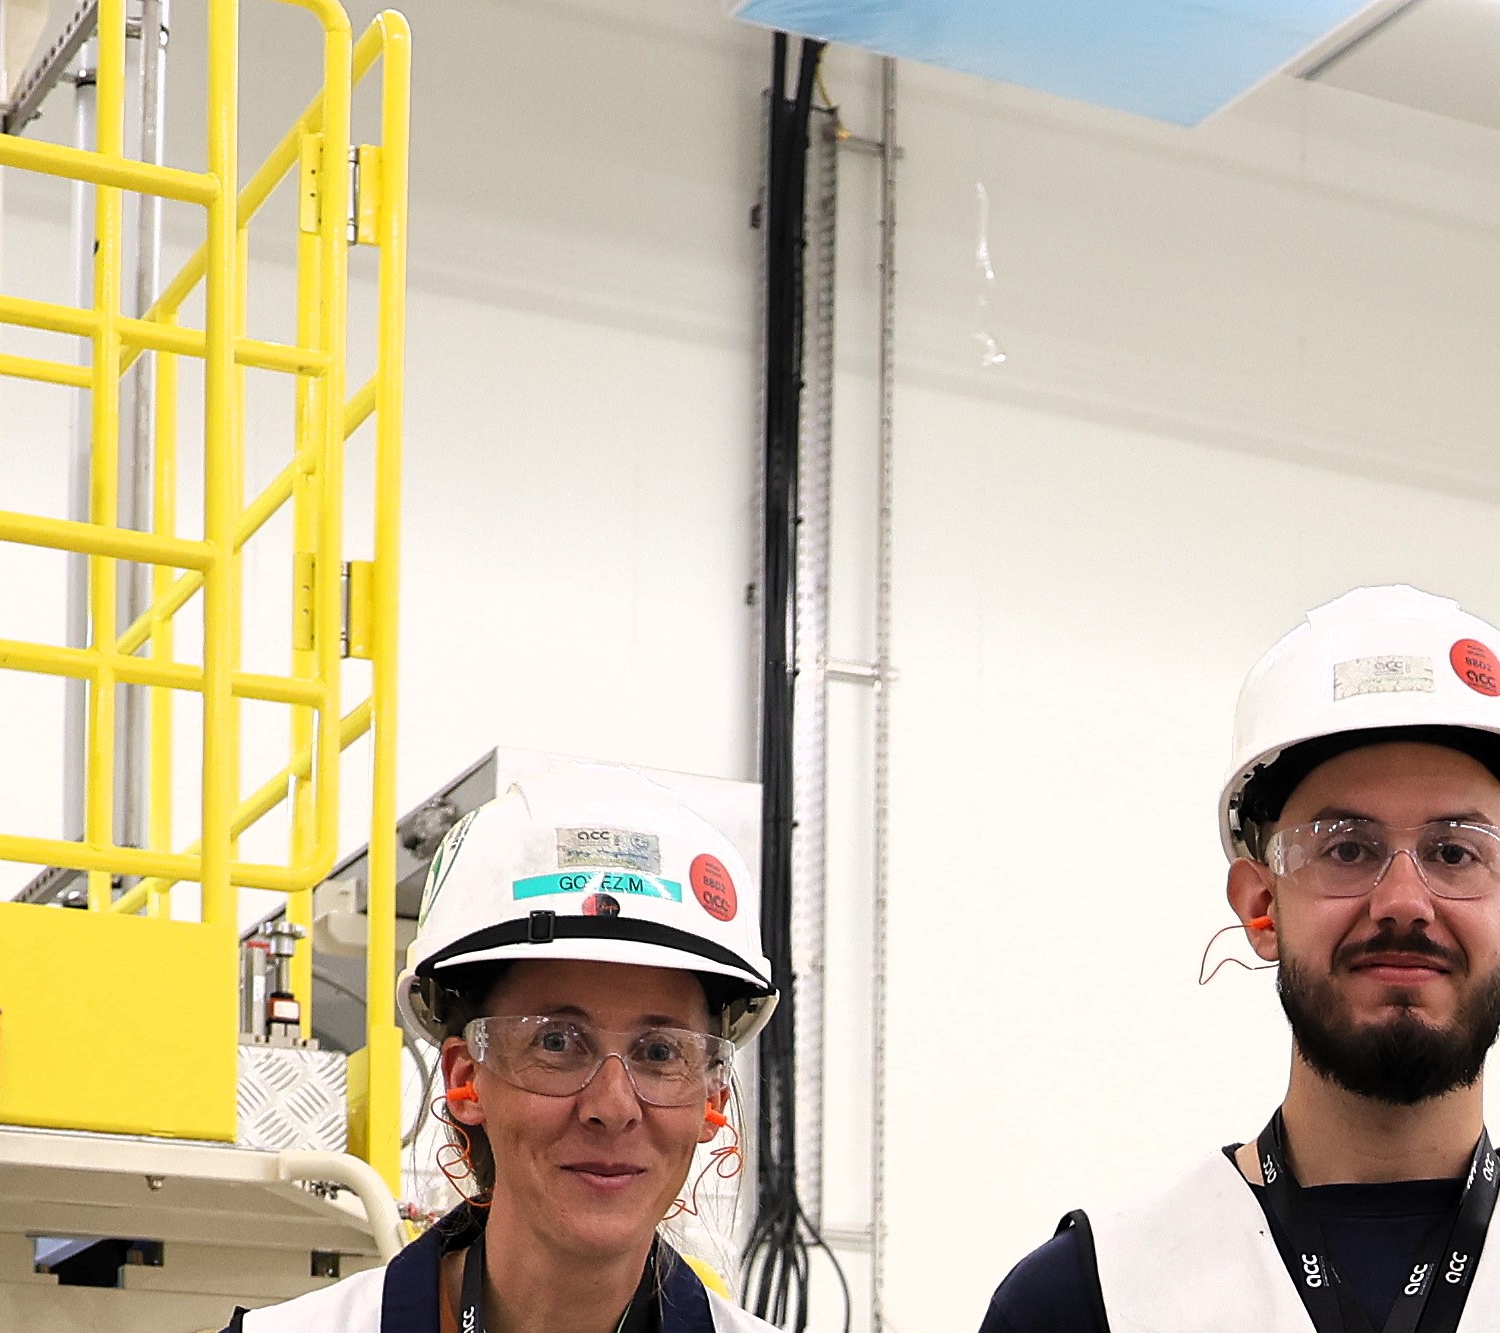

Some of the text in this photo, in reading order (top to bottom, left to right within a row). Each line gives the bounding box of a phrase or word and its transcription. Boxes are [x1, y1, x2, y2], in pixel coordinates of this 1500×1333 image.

[1466, 670, 1496, 687] acc
[577, 831, 610, 840] acc
[559, 875, 644, 892] GOEZ.M
[703, 891, 731, 911] acc
[1302, 1253, 1322, 1288] acc
[1445, 1251, 1468, 1284] acc
[1404, 1263, 1428, 1295] acc
